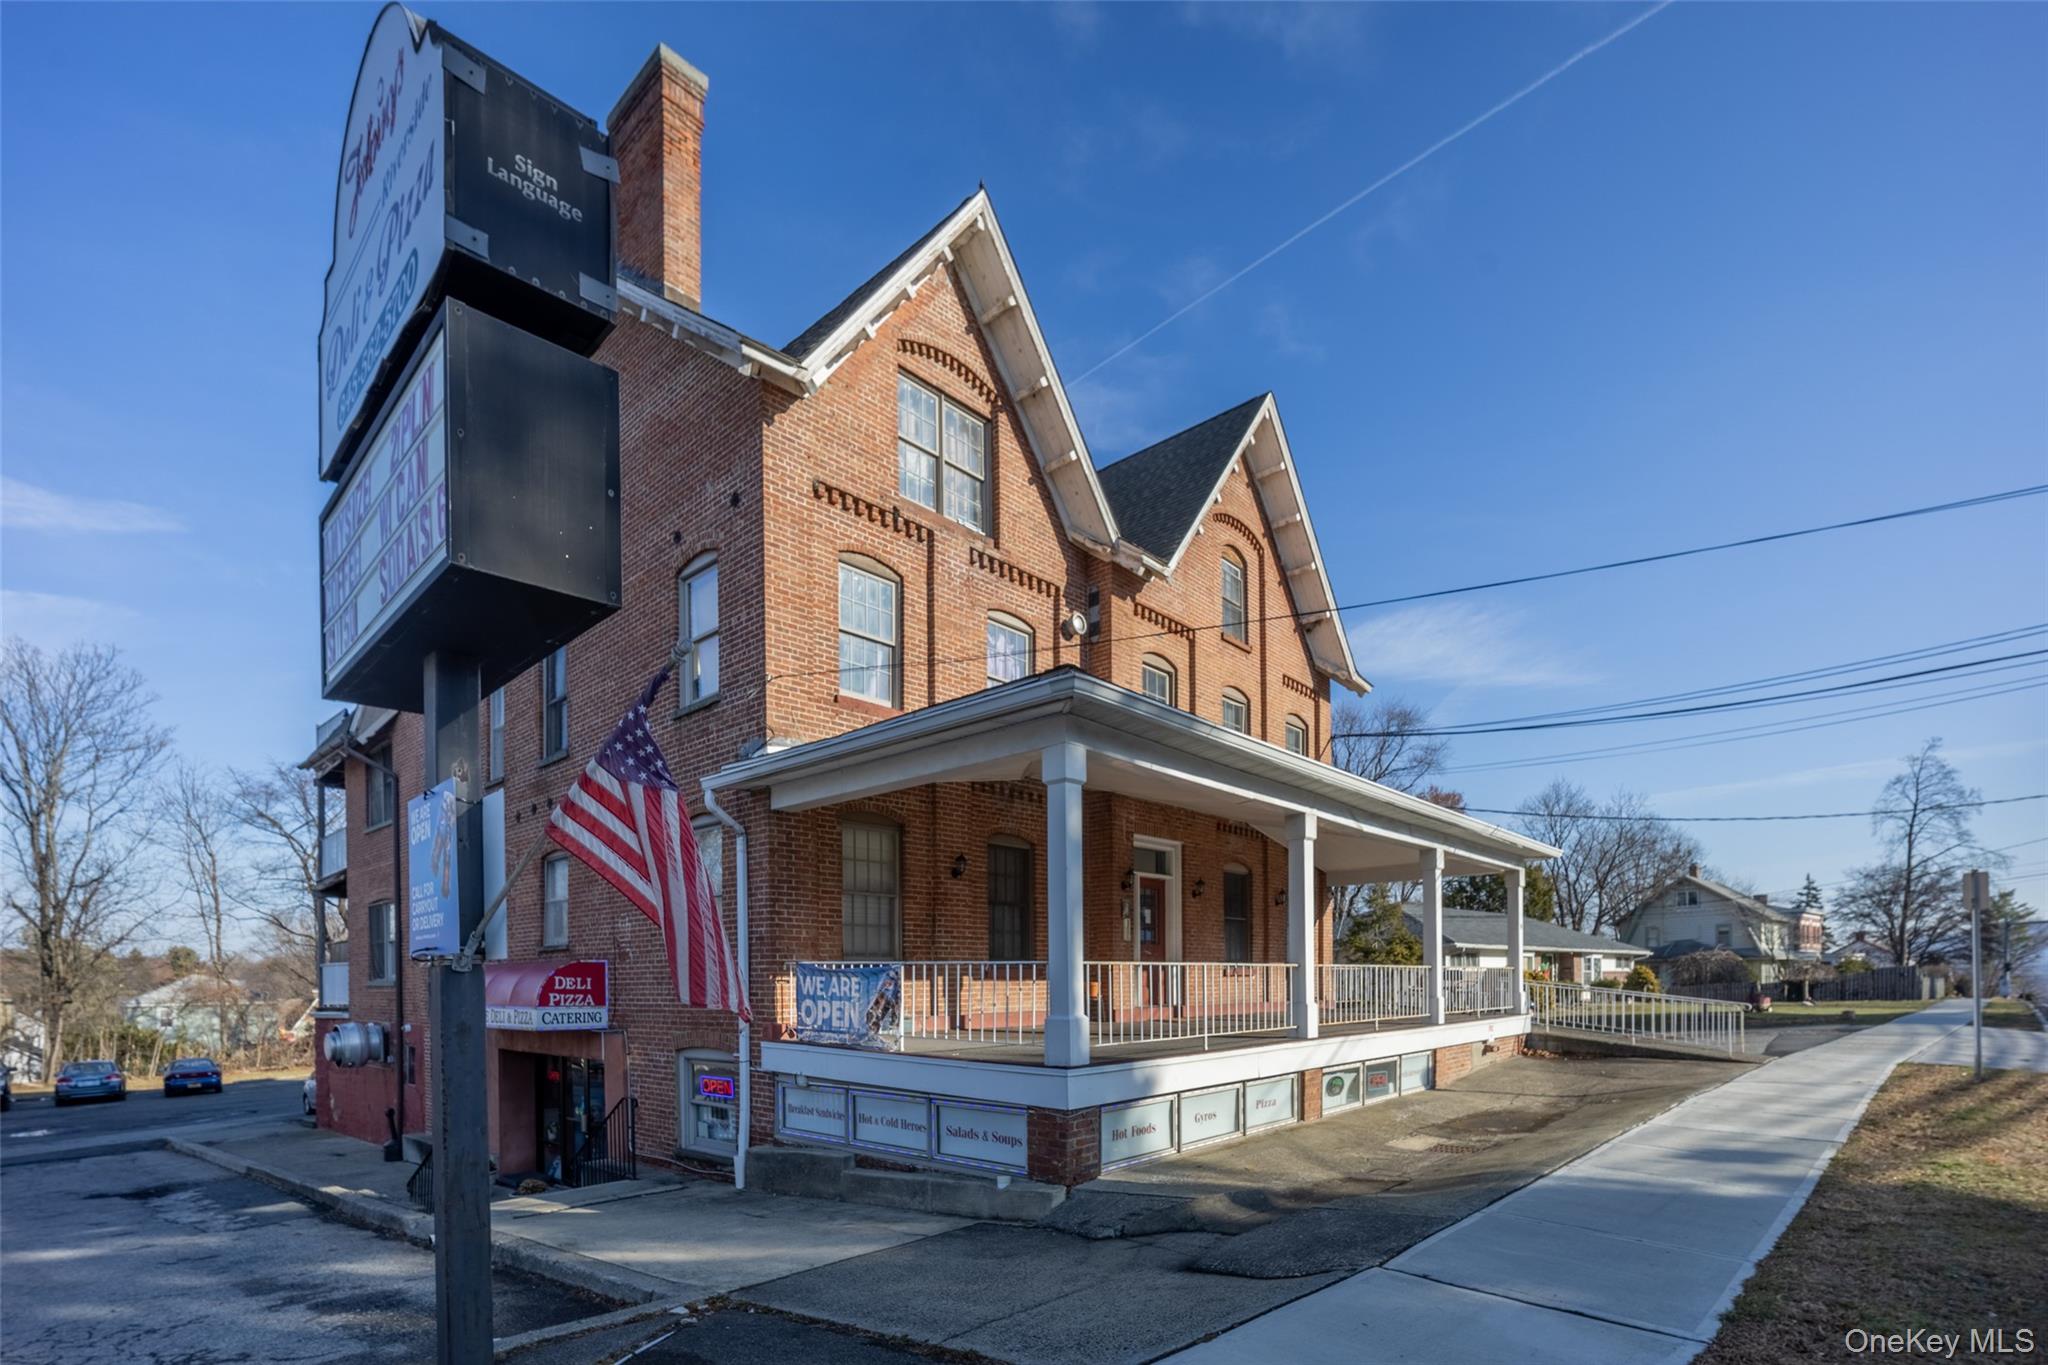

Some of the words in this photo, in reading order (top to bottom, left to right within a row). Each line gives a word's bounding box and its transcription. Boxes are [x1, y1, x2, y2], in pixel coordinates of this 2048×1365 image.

[514, 153, 558, 192] Sign
[487, 156, 583, 223] Language
[326, 284, 361, 400] Deli
[375, 138, 436, 298] Pizza
[396, 435, 429, 520] CAN
[379, 520, 417, 605] SODA
[411, 807, 419, 823] WE
[420, 803, 431, 820] ARE
[411, 820, 431, 845] OPEN
[412, 884, 424, 899] CALL
[424, 881, 434, 897] FOR
[412, 897, 438, 915] CARRYOUT
[412, 918, 418, 931] OR
[419, 913, 445, 930] DELIVERY
[554, 976, 592, 990] DELI
[800, 975, 825, 996] WE
[828, 976, 860, 998] ARE
[549, 993, 595, 1006] PIZZA
[491, 1008, 506, 1023] DELI
[513, 1009, 534, 1025] PIZZA
[541, 1011, 602, 1024] CATERING
[801, 999, 860, 1028] OPEN
[703, 1078, 731, 1094] OPEN
[1255, 1098, 1277, 1110] Pizza
[858, 1112, 872, 1124] Hot
[880, 1116, 899, 1129] Cold
[901, 1119, 927, 1133] Heroes
[1194, 1112, 1217, 1126] Gyros
[945, 1125, 979, 1140] Salads
[982, 1131, 989, 1142] &
[991, 1131, 1024, 1148] Soups
[1111, 1128, 1127, 1142] Hot
[1131, 1123, 1156, 1137] Foods
